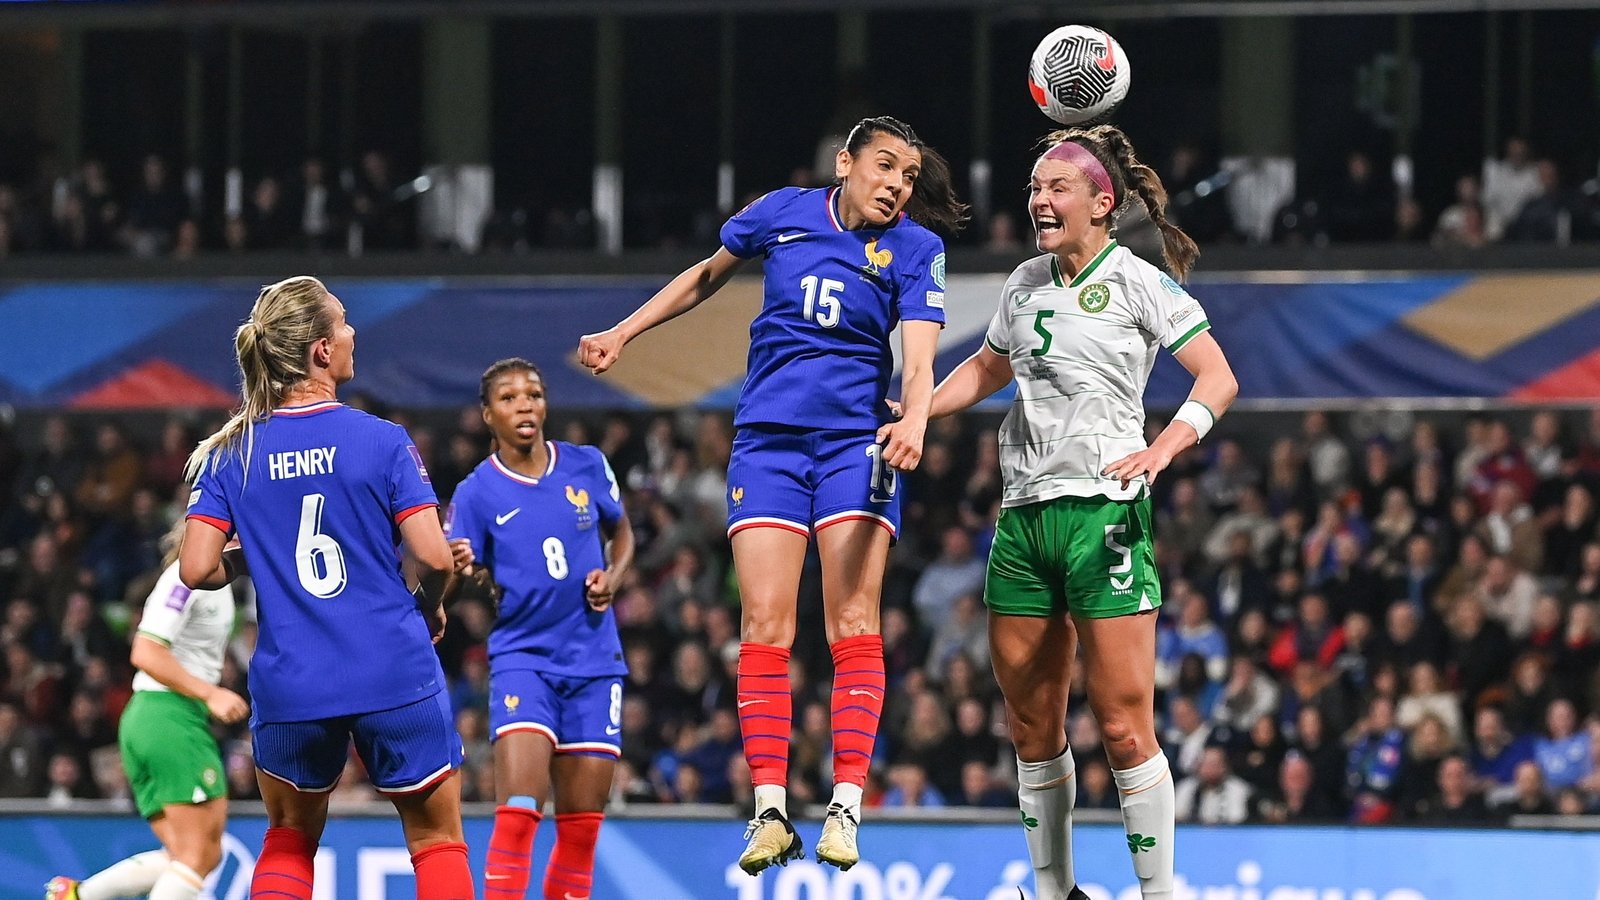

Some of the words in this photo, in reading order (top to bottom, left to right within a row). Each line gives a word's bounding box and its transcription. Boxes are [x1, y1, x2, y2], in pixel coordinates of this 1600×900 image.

[801, 275, 845, 329] 15
[1031, 310, 1055, 356] 5
[268, 446, 337, 480] HENRY
[295, 493, 348, 599] 6
[542, 536, 569, 581] 8
[1104, 524, 1132, 574] 5
[609, 682, 623, 715] 8
